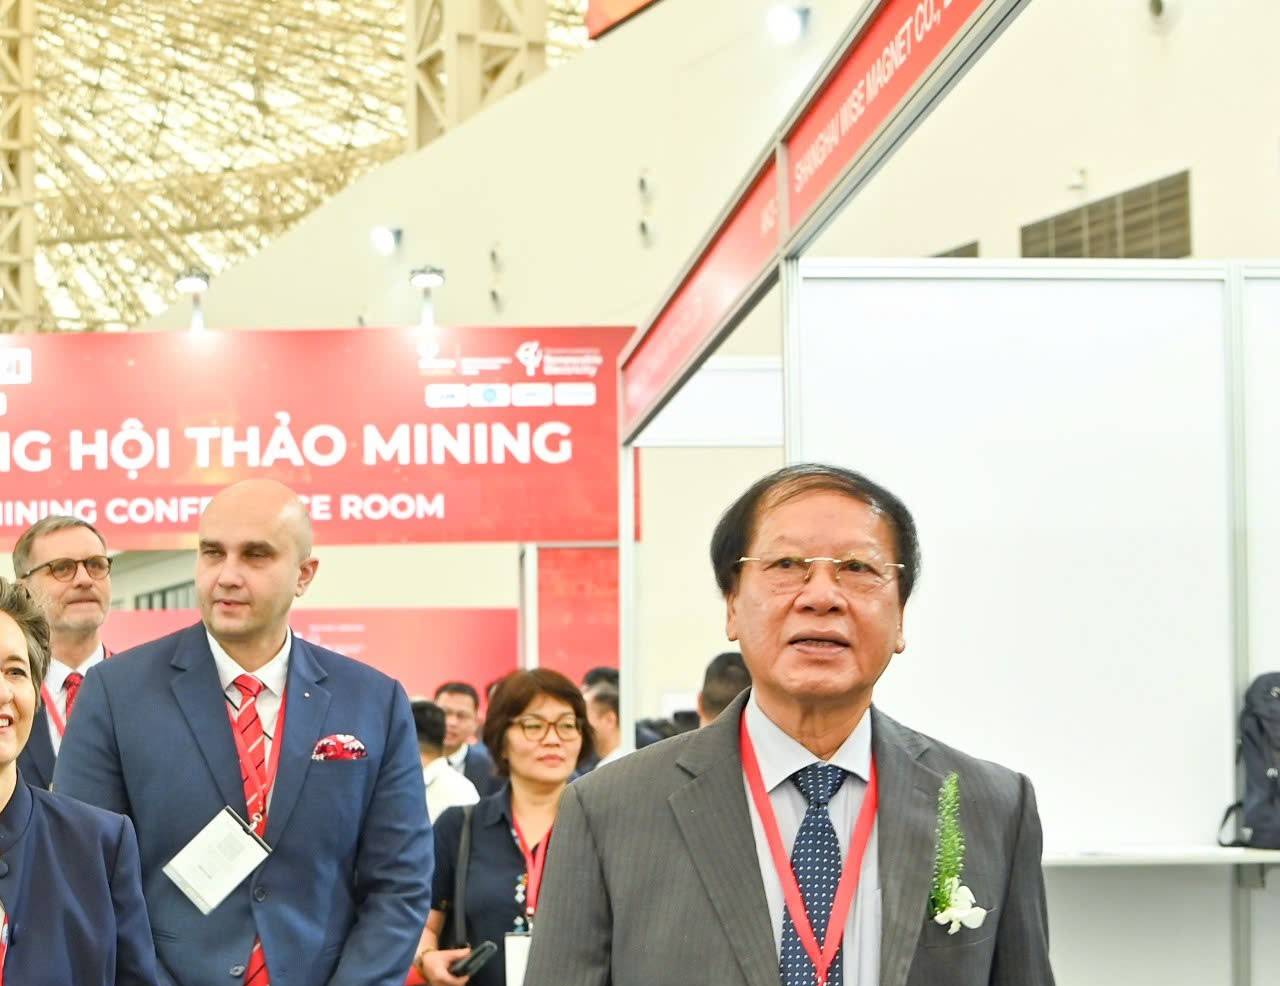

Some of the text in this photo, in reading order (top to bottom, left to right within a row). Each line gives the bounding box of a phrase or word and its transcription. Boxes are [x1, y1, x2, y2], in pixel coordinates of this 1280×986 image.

[838, 79, 866, 137] WISE
[865, 16, 913, 104] MAGNET
[69, 418, 170, 481] HỘI
[184, 411, 347, 468] THẢO
[362, 421, 573, 466] MINING
[340, 492, 446, 521] ROOM
